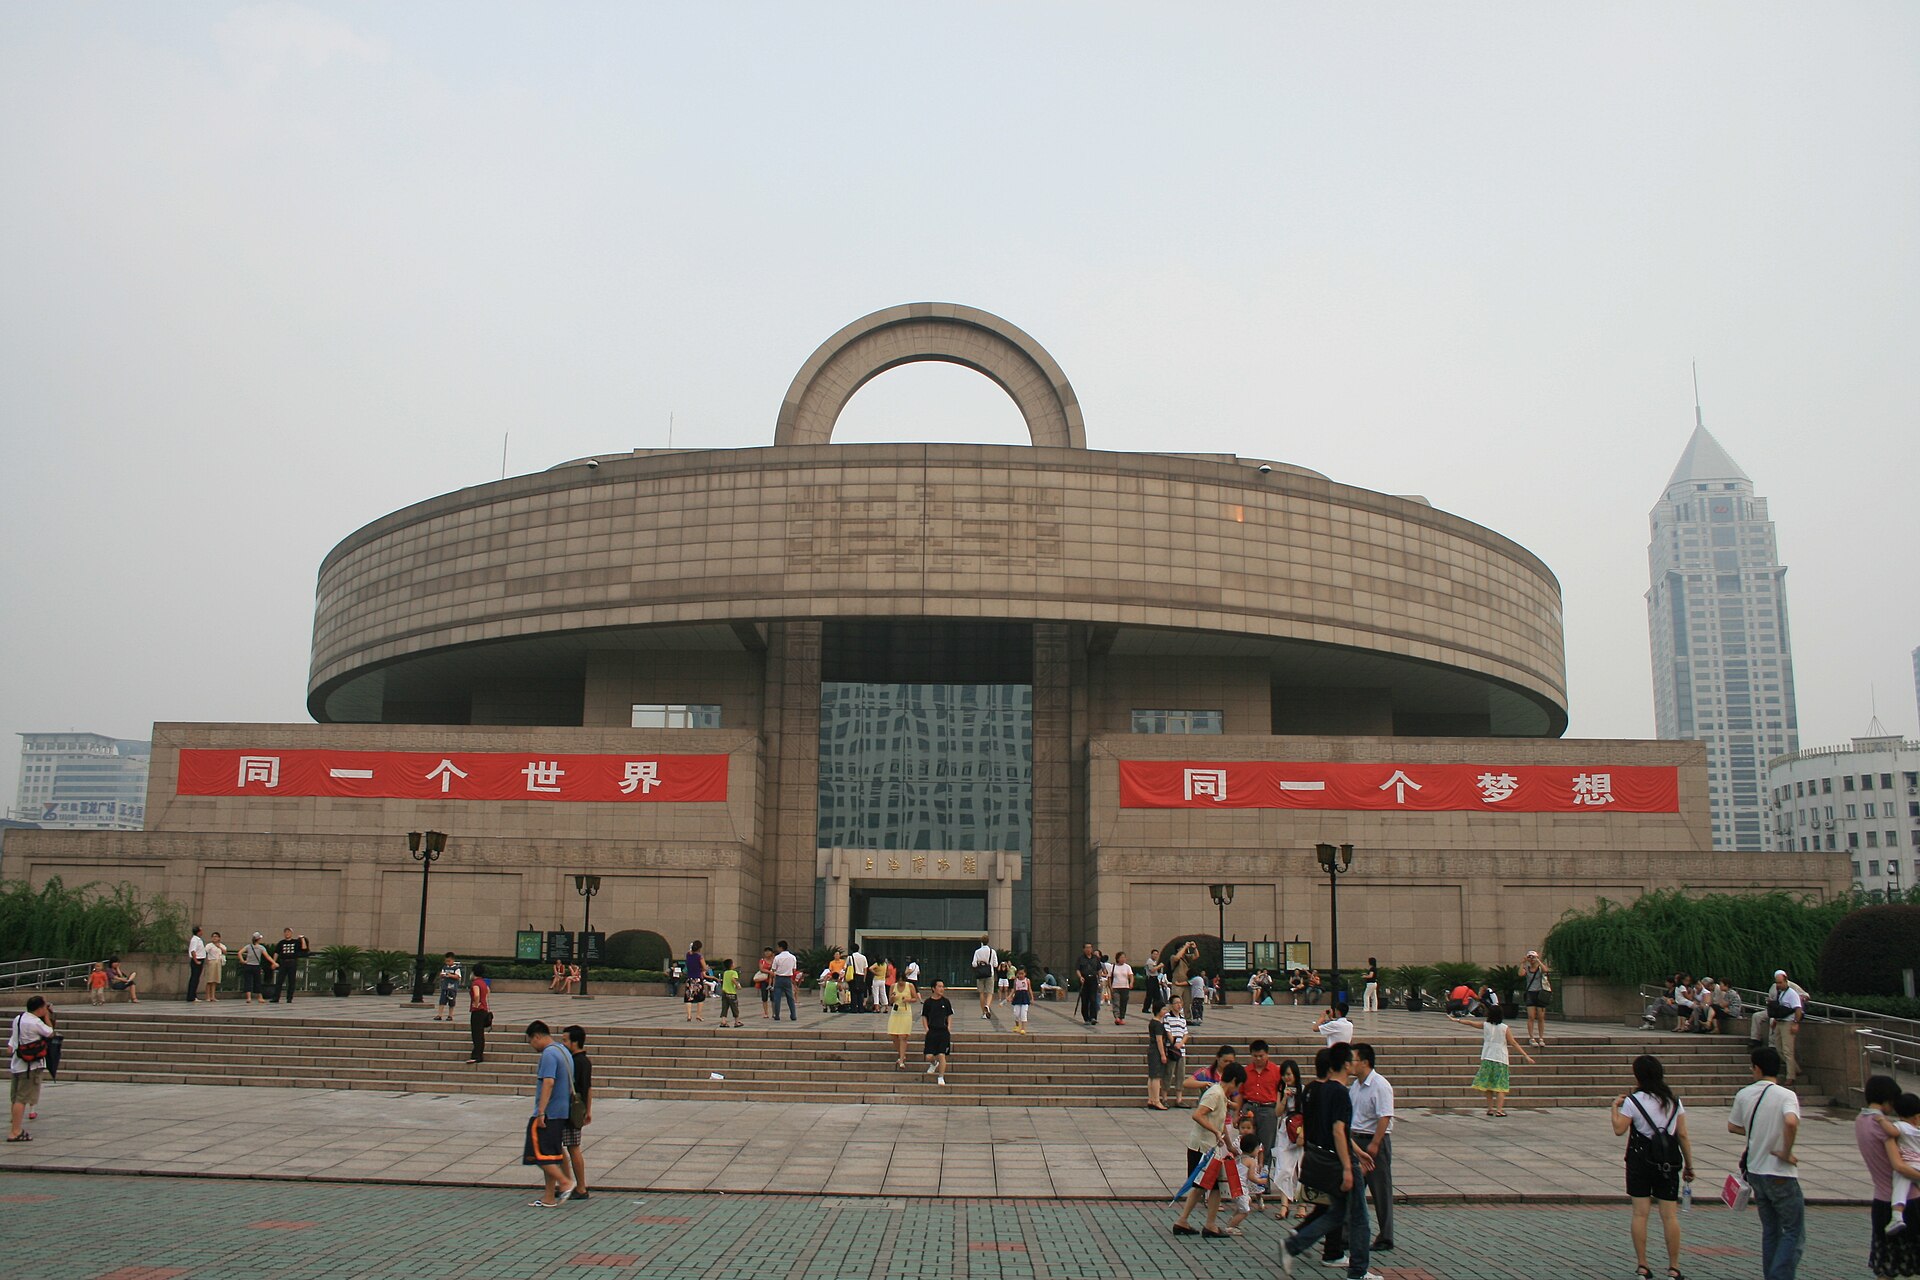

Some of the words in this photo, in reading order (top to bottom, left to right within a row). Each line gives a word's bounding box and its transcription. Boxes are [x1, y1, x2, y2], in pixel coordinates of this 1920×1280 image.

[237, 756, 661, 794] 同一个世界
[1183, 768, 1615, 806] 同一个梦想
